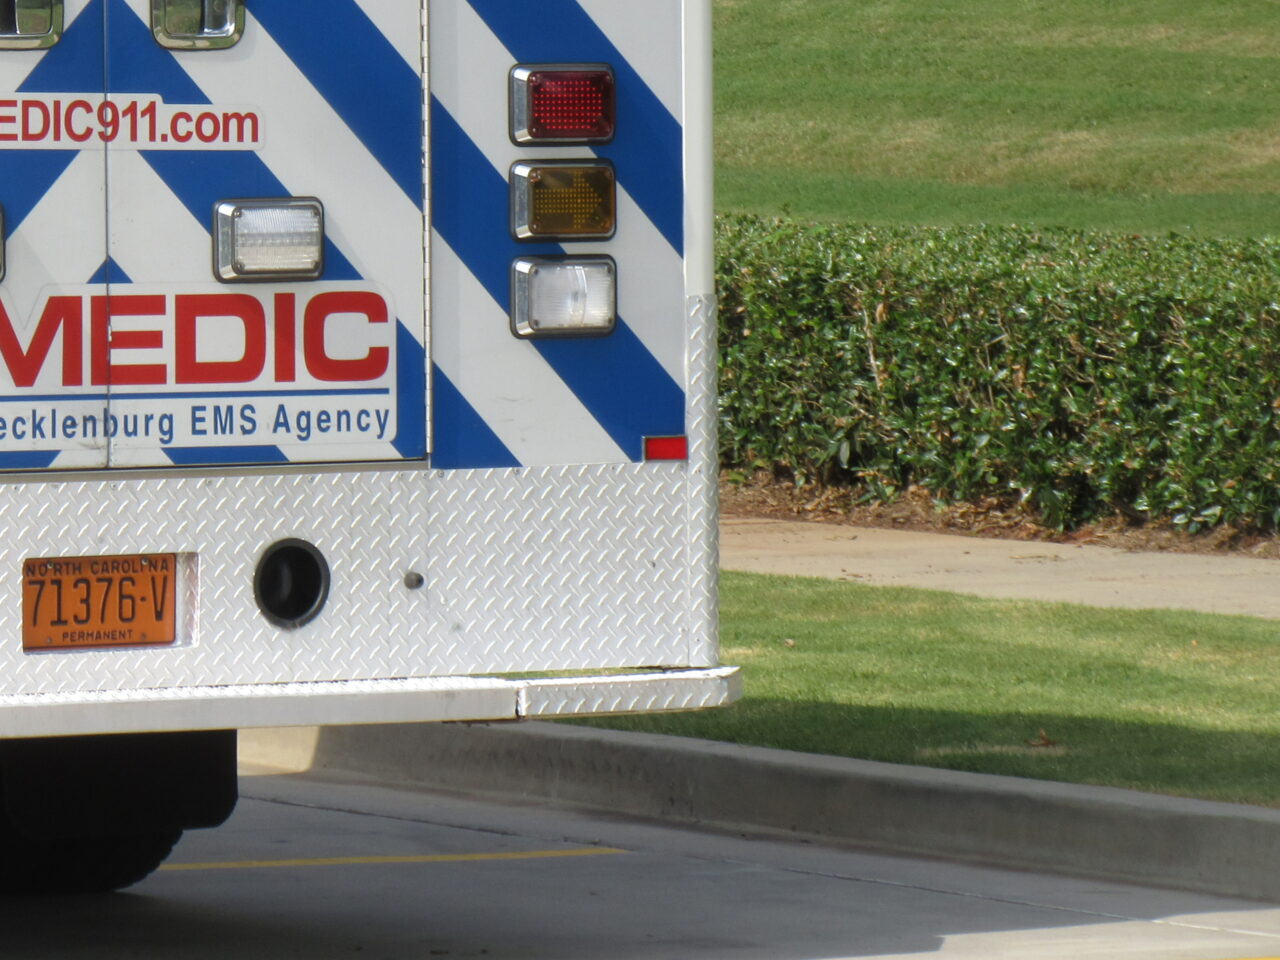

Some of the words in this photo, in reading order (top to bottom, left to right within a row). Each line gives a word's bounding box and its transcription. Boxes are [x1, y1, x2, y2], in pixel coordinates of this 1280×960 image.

[191, 404, 257, 438] EMS
[272, 403, 390, 440] Agency
[26, 562, 82, 577] NORTH
[90, 559, 169, 574] CAROLINA
[62, 629, 134, 642] PERMANENT
